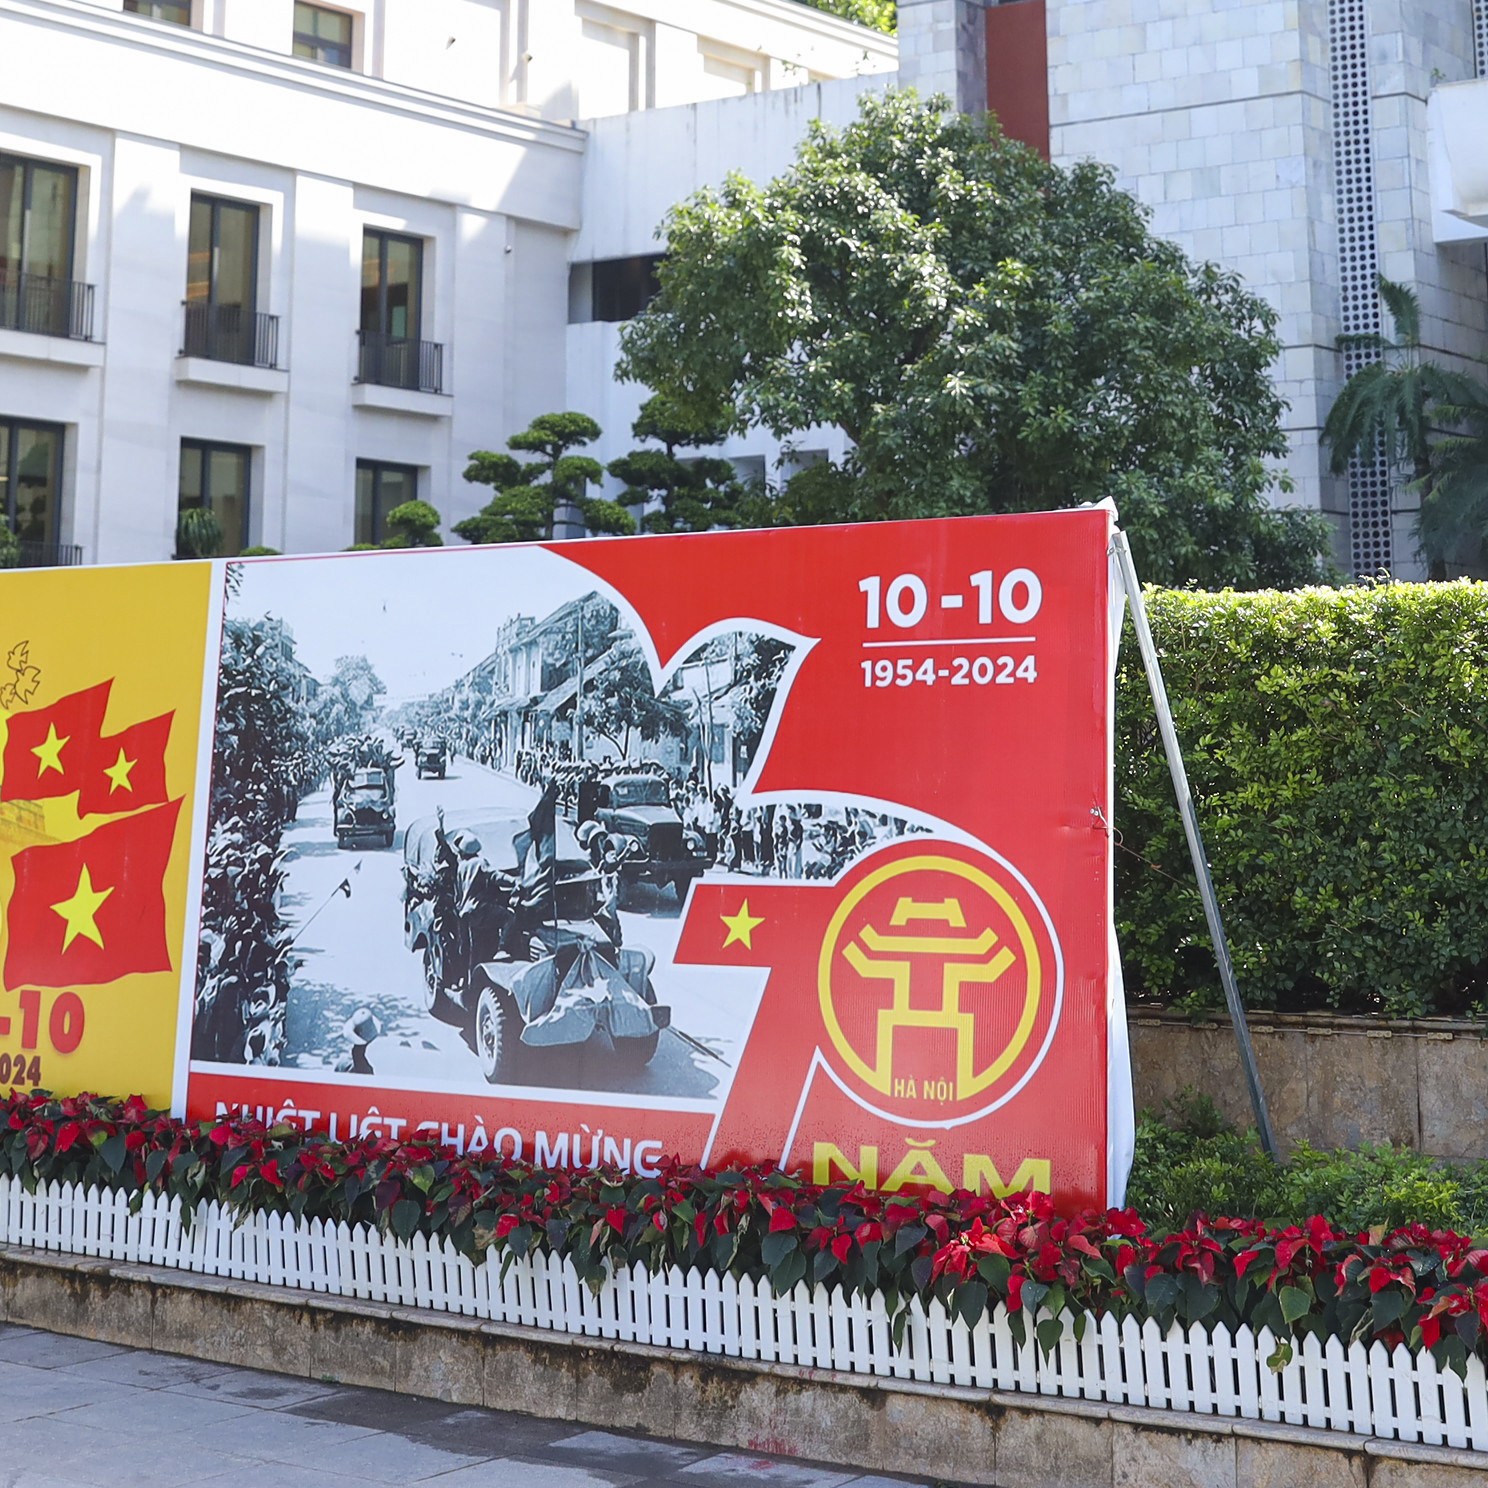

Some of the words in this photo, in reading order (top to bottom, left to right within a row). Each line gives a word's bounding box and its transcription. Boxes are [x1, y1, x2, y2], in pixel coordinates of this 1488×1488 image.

[858, 567, 1043, 629] 10-10
[860, 655, 1038, 688] 1954-2024
[894, 1075, 917, 1100] HÀ
[923, 1076, 954, 1106] NỘI
[534, 1123, 664, 1179] MỪNG
[813, 1137, 1052, 1200] NĂM
